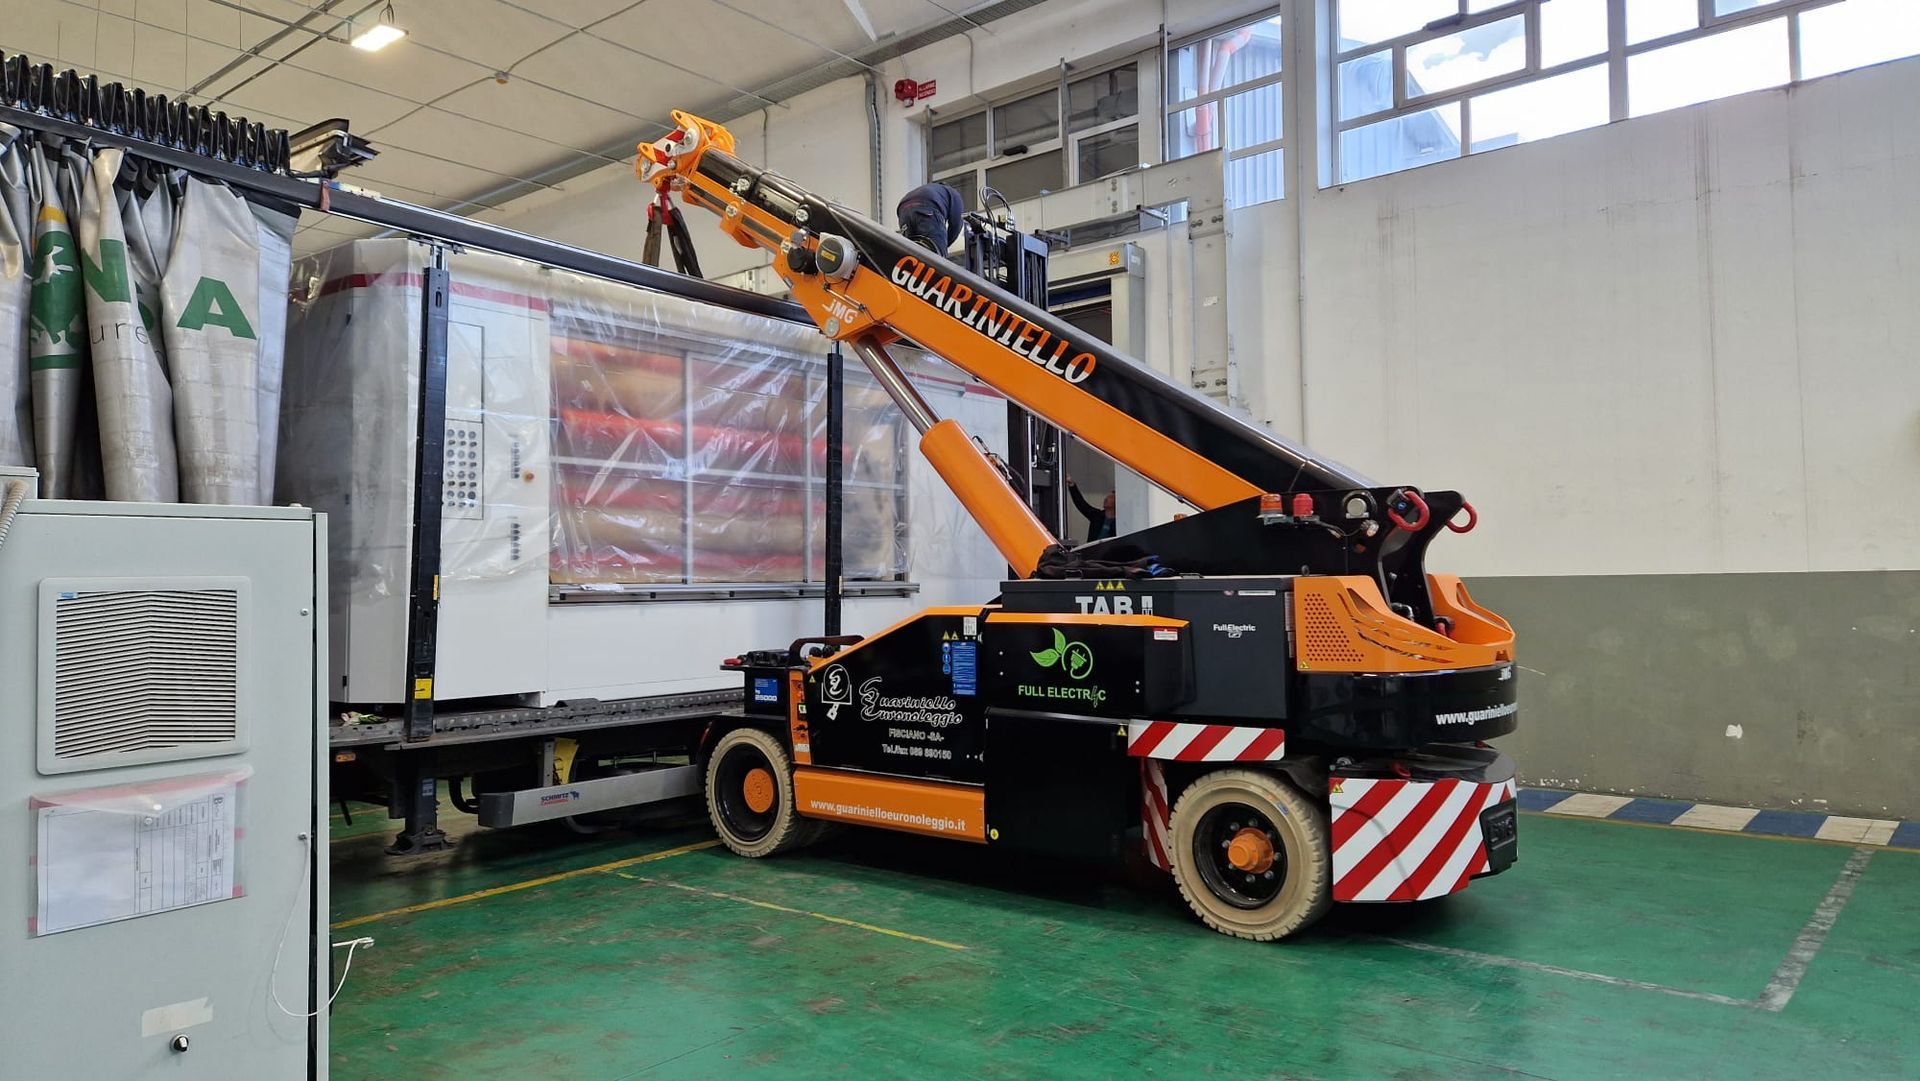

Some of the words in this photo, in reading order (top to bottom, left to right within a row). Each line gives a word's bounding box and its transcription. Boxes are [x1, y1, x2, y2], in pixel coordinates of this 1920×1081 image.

[822, 299, 858, 325] JMG
[891, 255, 1097, 384] GUARINIELLO
[1018, 685, 1045, 698] FULL
[810, 800, 966, 831] www.guarinielloeuronoleggio.it
